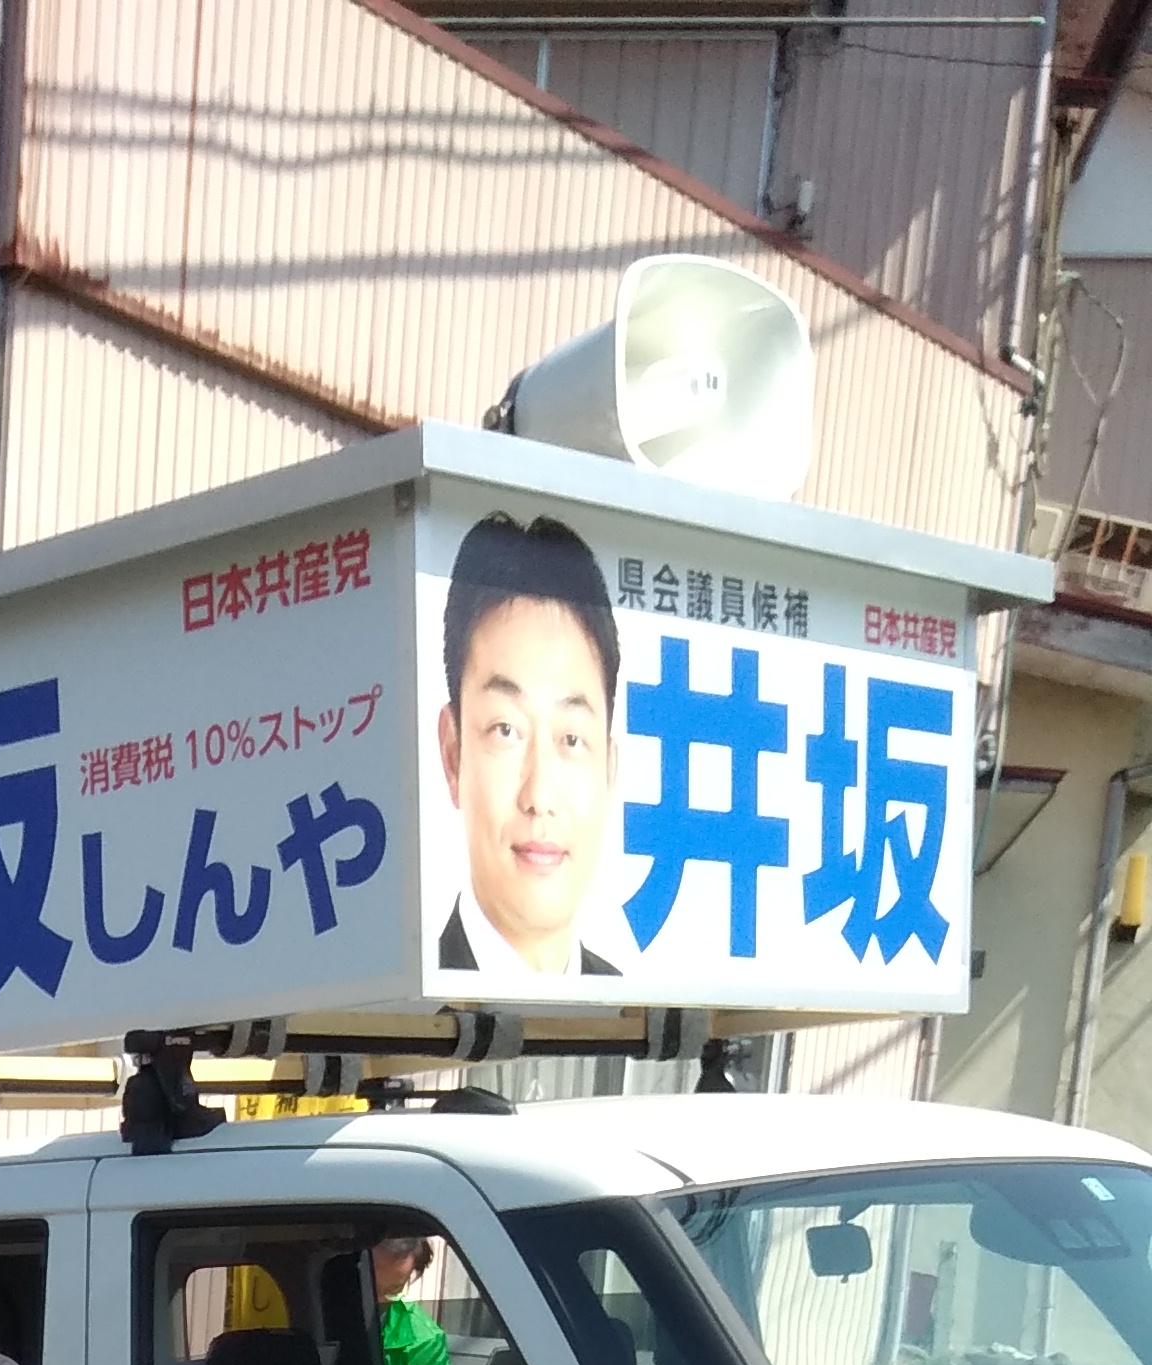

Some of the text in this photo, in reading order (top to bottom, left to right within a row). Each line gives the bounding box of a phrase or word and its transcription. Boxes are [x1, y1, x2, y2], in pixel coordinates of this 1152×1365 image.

[181, 528, 372, 632] 日本共産党
[617, 556, 810, 638] 県会議員候補
[864, 604, 957, 659] 日本共産党
[621, 635, 954, 966] 井坂
[80, 780, 388, 966] しんや
